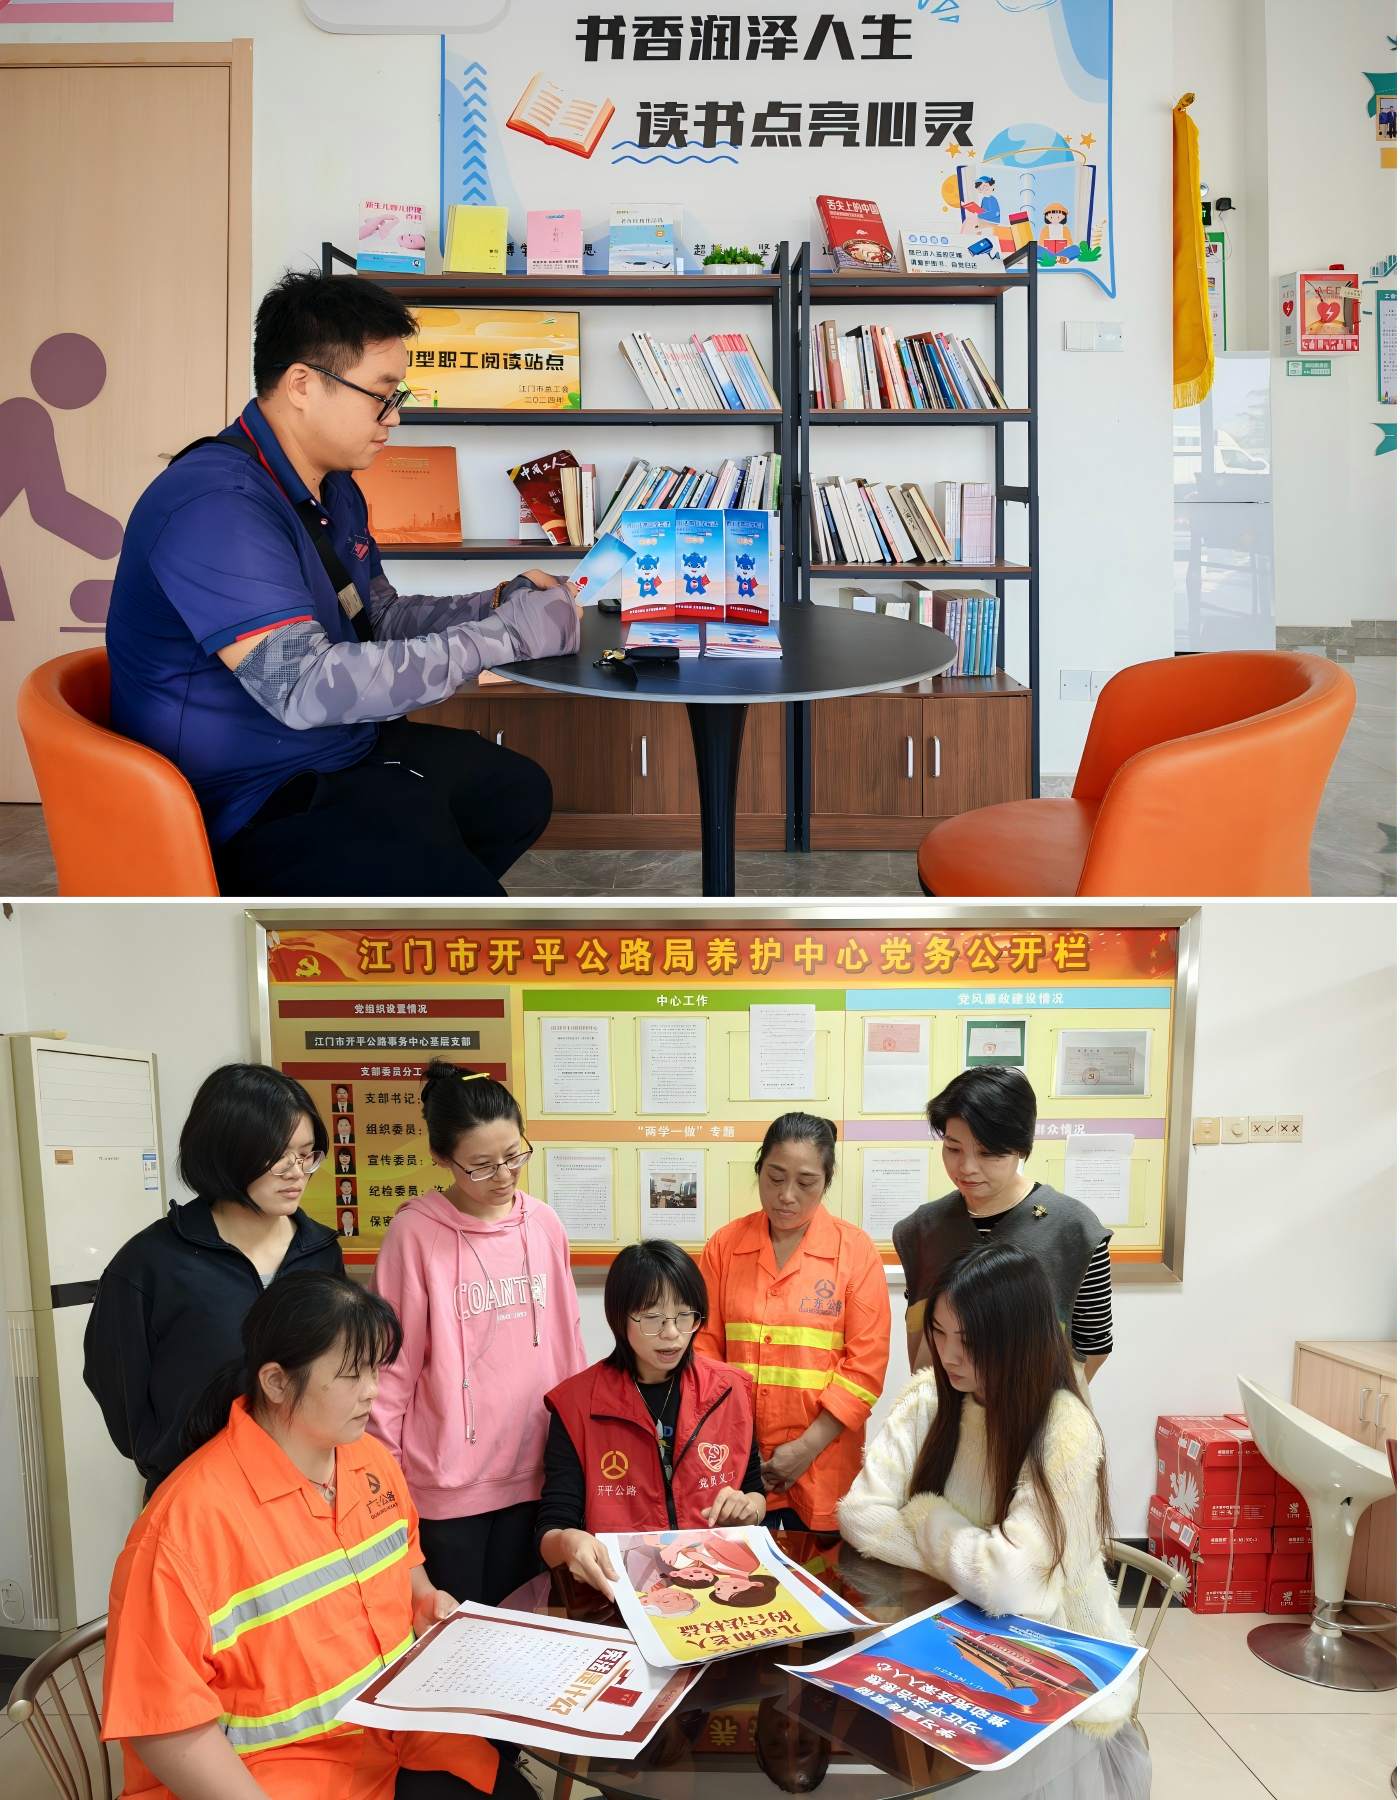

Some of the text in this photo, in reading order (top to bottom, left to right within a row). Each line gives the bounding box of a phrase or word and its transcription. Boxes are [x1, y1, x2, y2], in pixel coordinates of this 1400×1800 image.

[575, 13, 913, 62] 书香润泽人生
[635, 100, 974, 149] 读书点亮心灵
[826, 198, 880, 215] 舌尖上的中国
[1282, 290, 1295, 299] AED
[518, 384, 569, 394] 江门市总工会
[519, 456, 567, 481] 中国工人
[358, 935, 1090, 974] 江门市开平公路局养护中心党务公开栏
[656, 994, 709, 1007] 中心工作
[957, 992, 1064, 1006] 党风廉政建设情况
[354, 1003, 428, 1015] 党组织设置情况
[314, 1035, 471, 1048] 江门市开平公路事务中心基层支部
[360, 1066, 423, 1077] 支部委员分工
[698, 1470, 736, 1490] 党员义工
